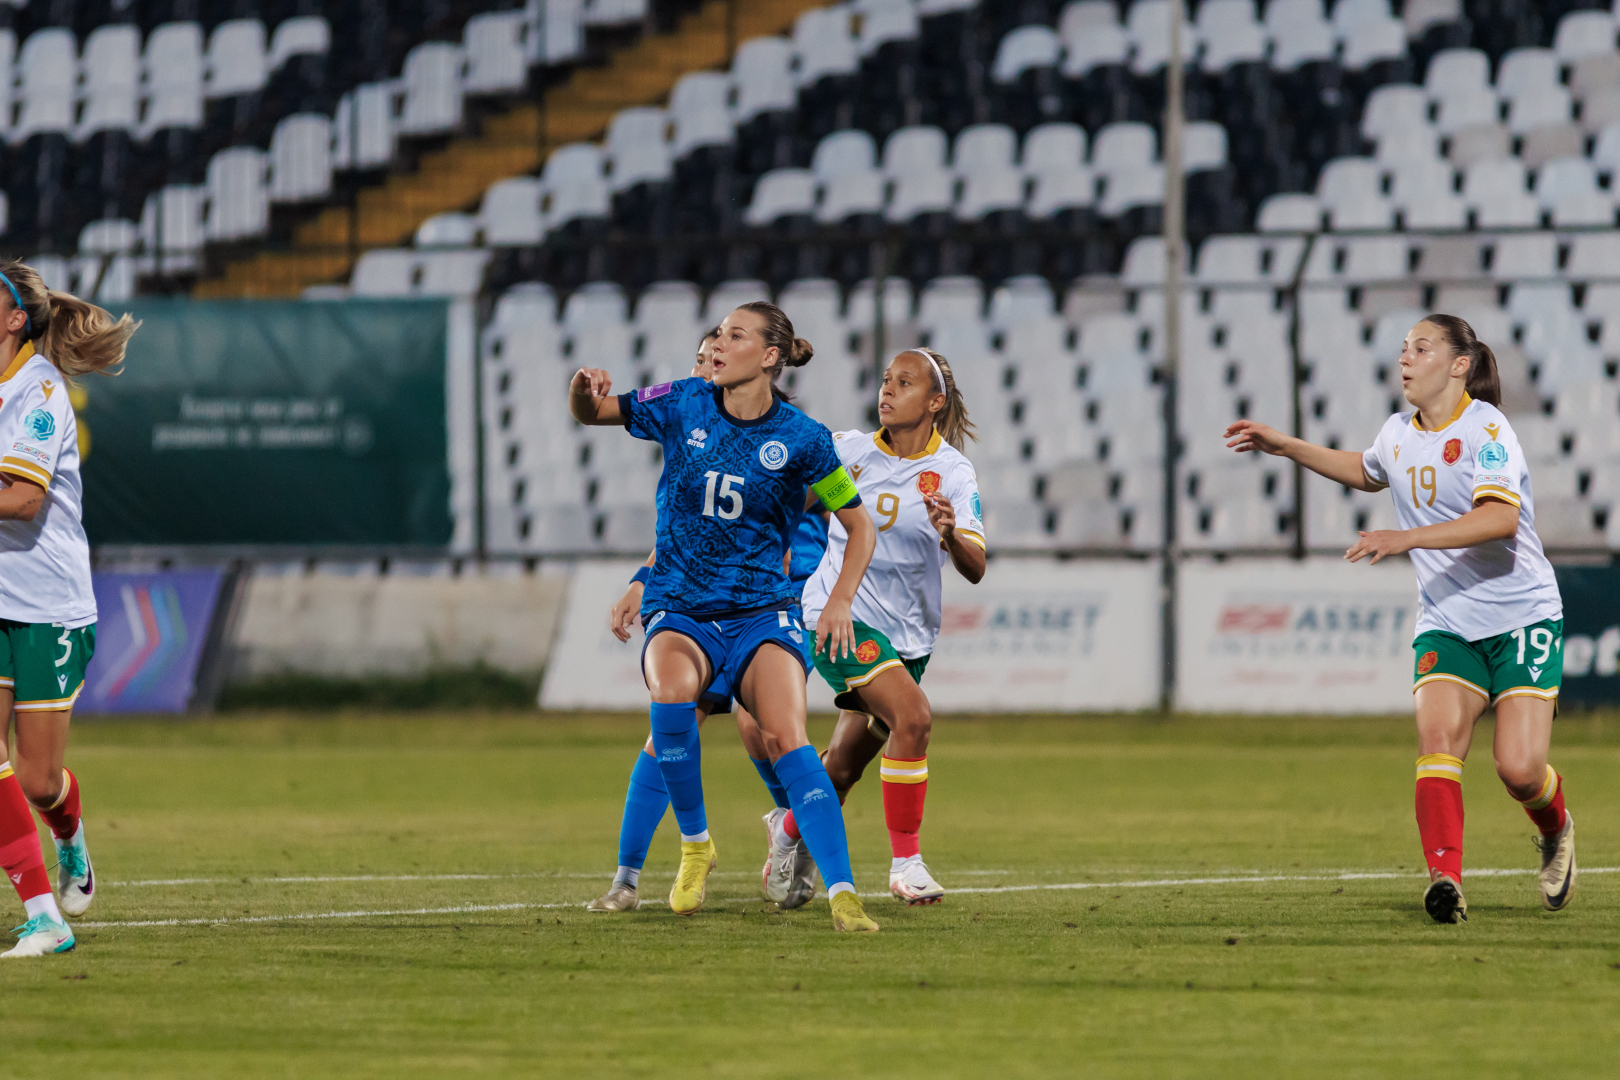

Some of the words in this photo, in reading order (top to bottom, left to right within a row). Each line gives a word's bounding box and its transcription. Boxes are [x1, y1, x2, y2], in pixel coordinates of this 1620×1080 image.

[702, 470, 745, 520] 15
[826, 478, 850, 498] RESPECT
[1406, 465, 1437, 509] 19
[876, 493, 900, 532] 9
[1296, 606, 1409, 631] ASSET
[52, 622, 73, 668] 3
[1510, 627, 1553, 665] 19
